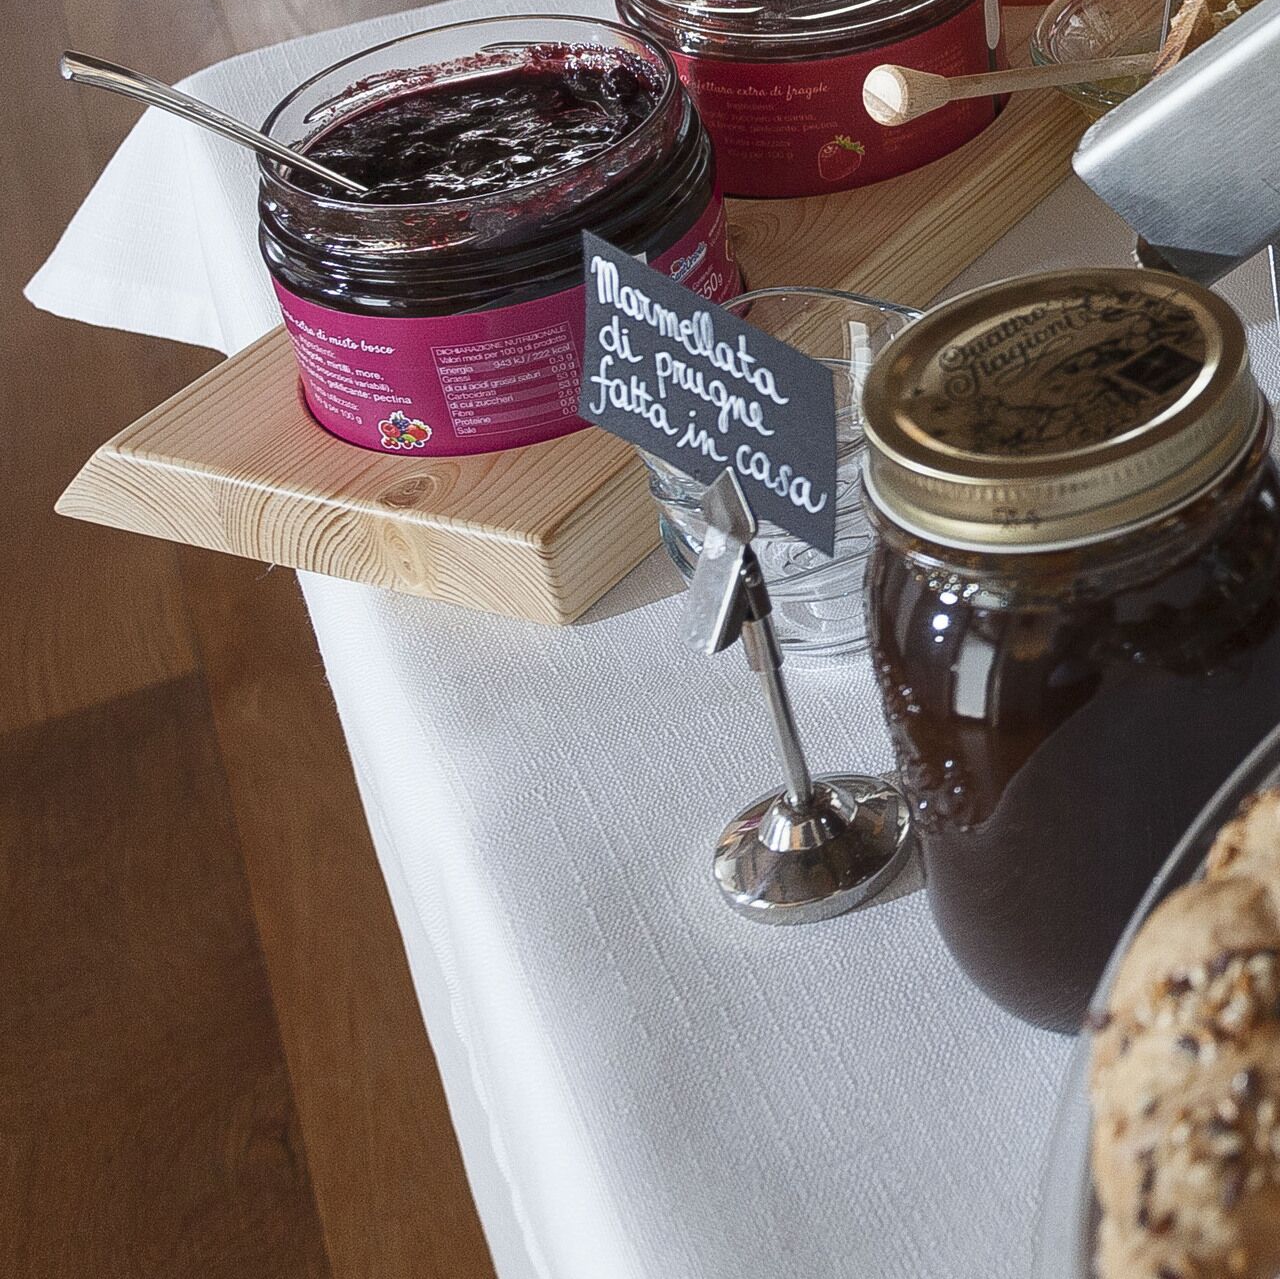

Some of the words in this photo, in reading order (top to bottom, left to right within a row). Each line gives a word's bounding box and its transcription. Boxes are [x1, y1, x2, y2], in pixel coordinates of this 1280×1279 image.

[736, 85, 768, 97] extra
[769, 88, 784, 97] di
[785, 81, 828, 102] fragole
[504, 324, 567, 347] NUTRIZIONALE
[590, 256, 789, 405] Marmellata
[316, 329, 329, 341] di
[329, 335, 359, 350] misto
[360, 340, 396, 354] bosco
[462, 351, 484, 362] medi
[483, 352, 498, 362] per
[501, 346, 516, 356] 100
[517, 346, 524, 355] g
[524, 342, 533, 351] di
[533, 333, 567, 350] prodotto
[439, 366, 474, 376] Energia
[492, 359, 513, 369] 943
[513, 356, 526, 366] kJ
[532, 350, 551, 361] 222
[551, 343, 571, 355] kcal
[442, 375, 471, 384] Grassi
[599, 315, 643, 363] di
[655, 351, 774, 434] prugne
[444, 384, 454, 393] di
[454, 382, 468, 393] cui
[446, 389, 497, 402] Carboidrati
[372, 393, 412, 405] pectina
[449, 401, 459, 410] di
[459, 399, 474, 409] cui
[474, 395, 514, 408] zuccheri
[451, 409, 475, 418] Fibre
[454, 416, 492, 427] Proteine
[456, 427, 477, 435] Sale
[589, 355, 678, 436] fatta
[676, 410, 728, 461] in
[735, 444, 828, 514] casa
